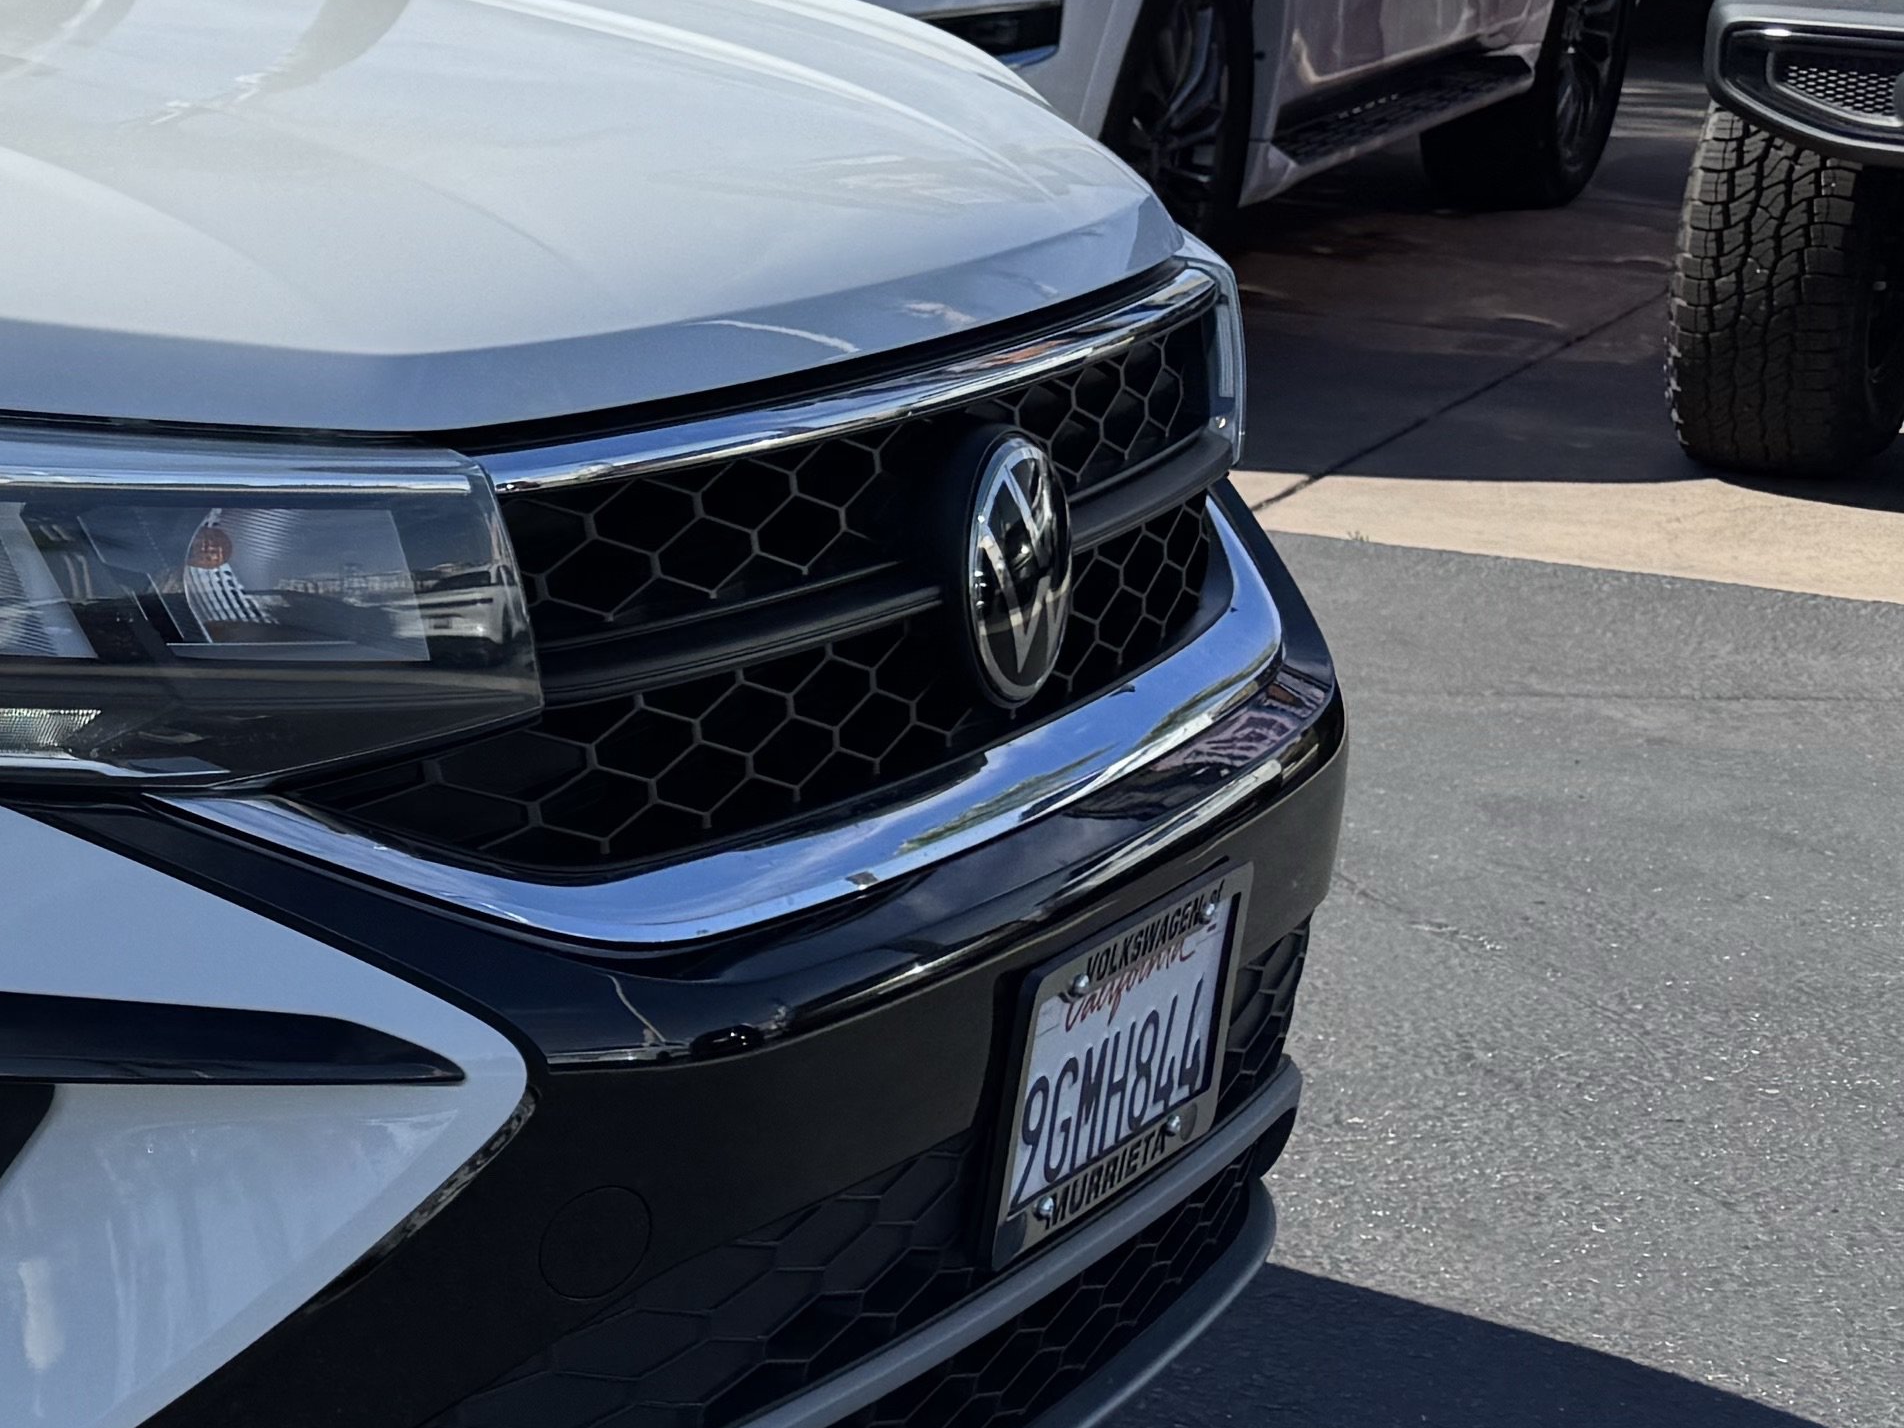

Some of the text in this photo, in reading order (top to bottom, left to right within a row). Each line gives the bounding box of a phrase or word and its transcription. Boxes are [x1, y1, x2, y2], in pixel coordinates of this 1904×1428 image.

[1065, 938, 1196, 1032] California
[1086, 893, 1204, 983] VOLKSWAGEN
[1010, 974, 1204, 1210] 9GMH844
[1045, 1124, 1168, 1229] MURRIETA
